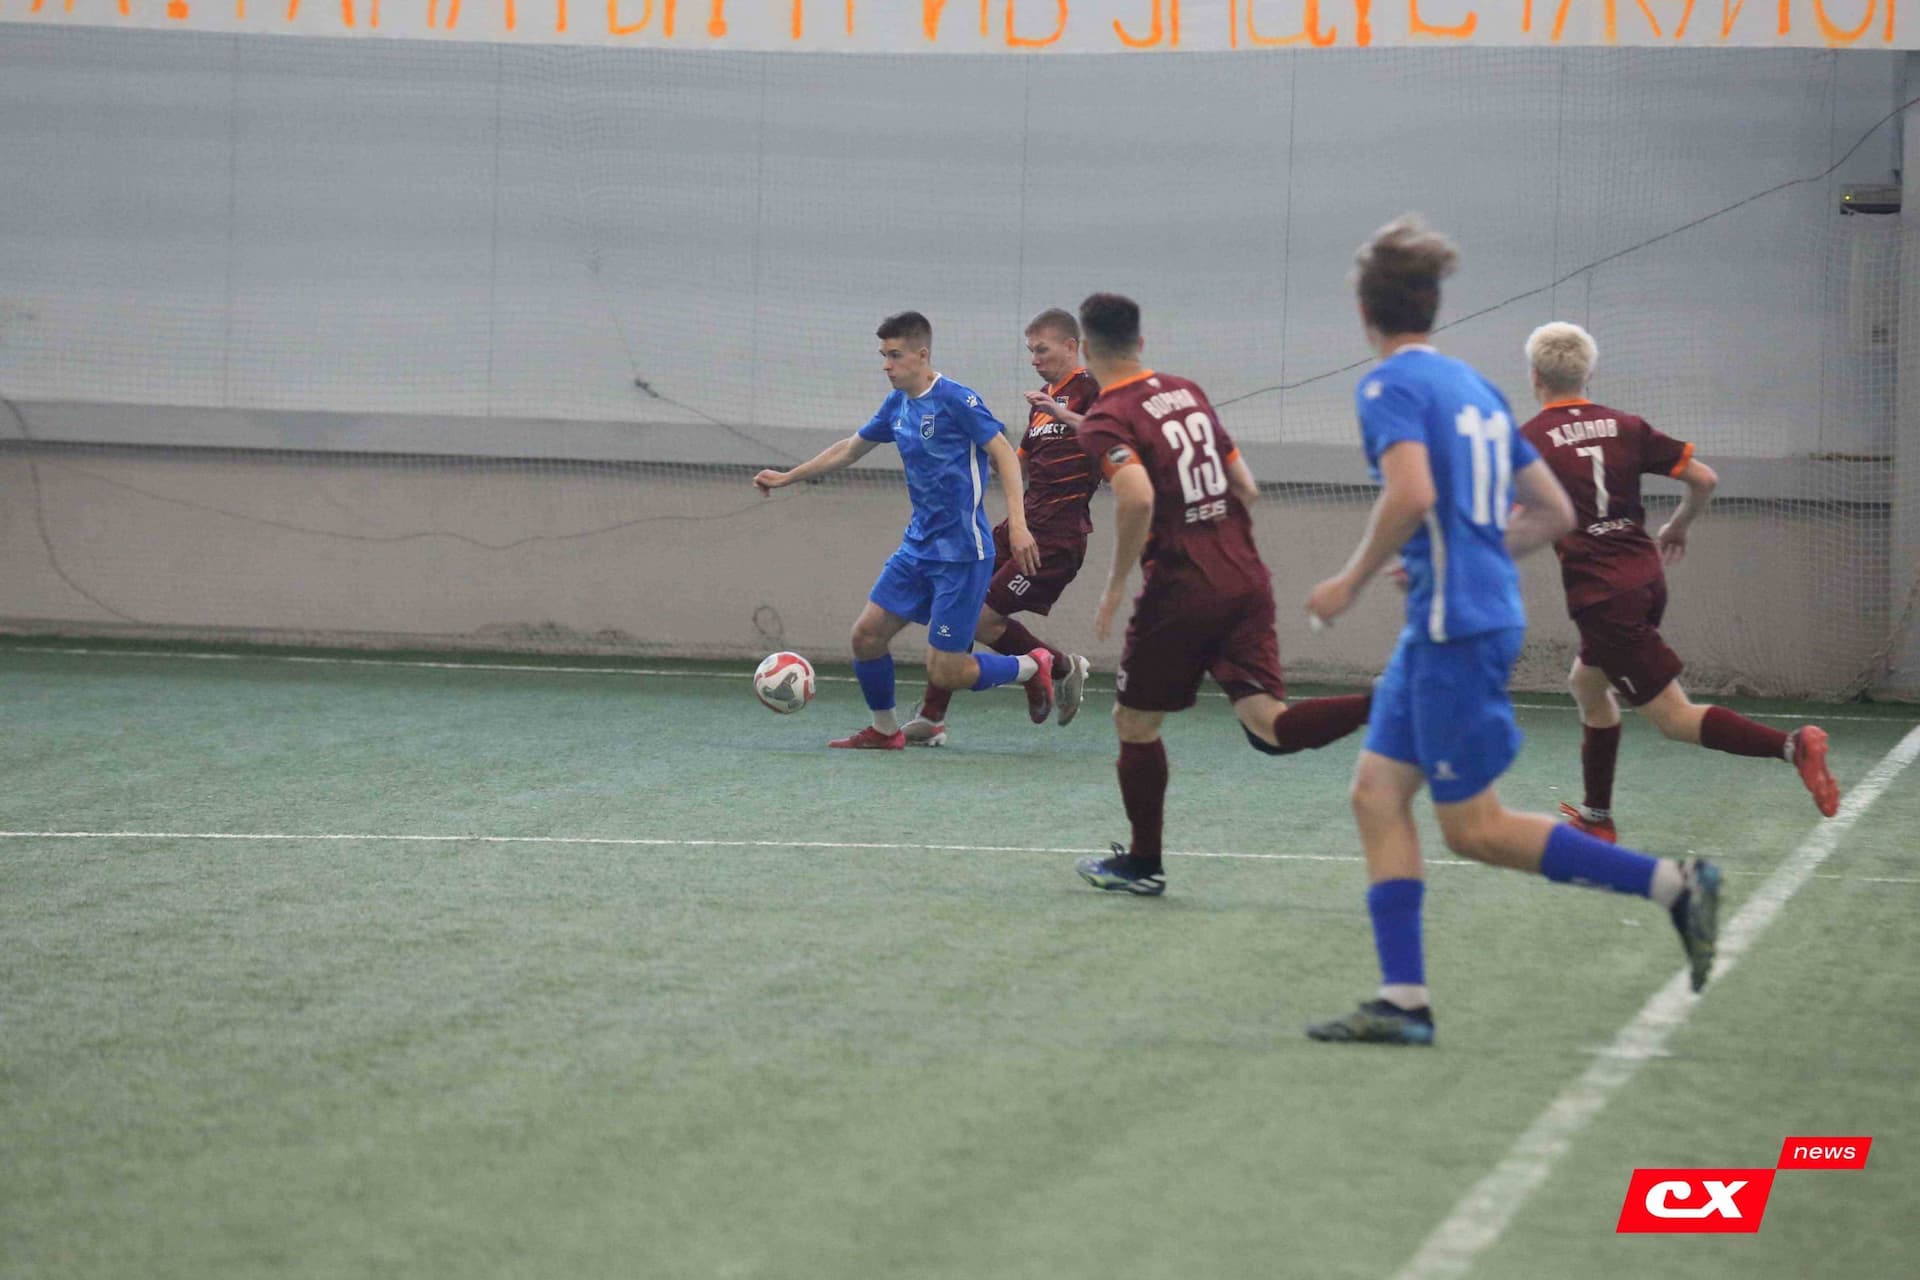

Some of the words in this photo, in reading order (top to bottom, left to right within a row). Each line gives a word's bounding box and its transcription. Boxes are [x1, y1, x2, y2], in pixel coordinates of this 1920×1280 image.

[1161, 411, 1228, 504] 23
[1455, 404, 1511, 529] 11
[1546, 418, 1618, 448] ЖДАНОВ
[1576, 445, 1609, 518] 7
[1007, 574, 1031, 596] 20
